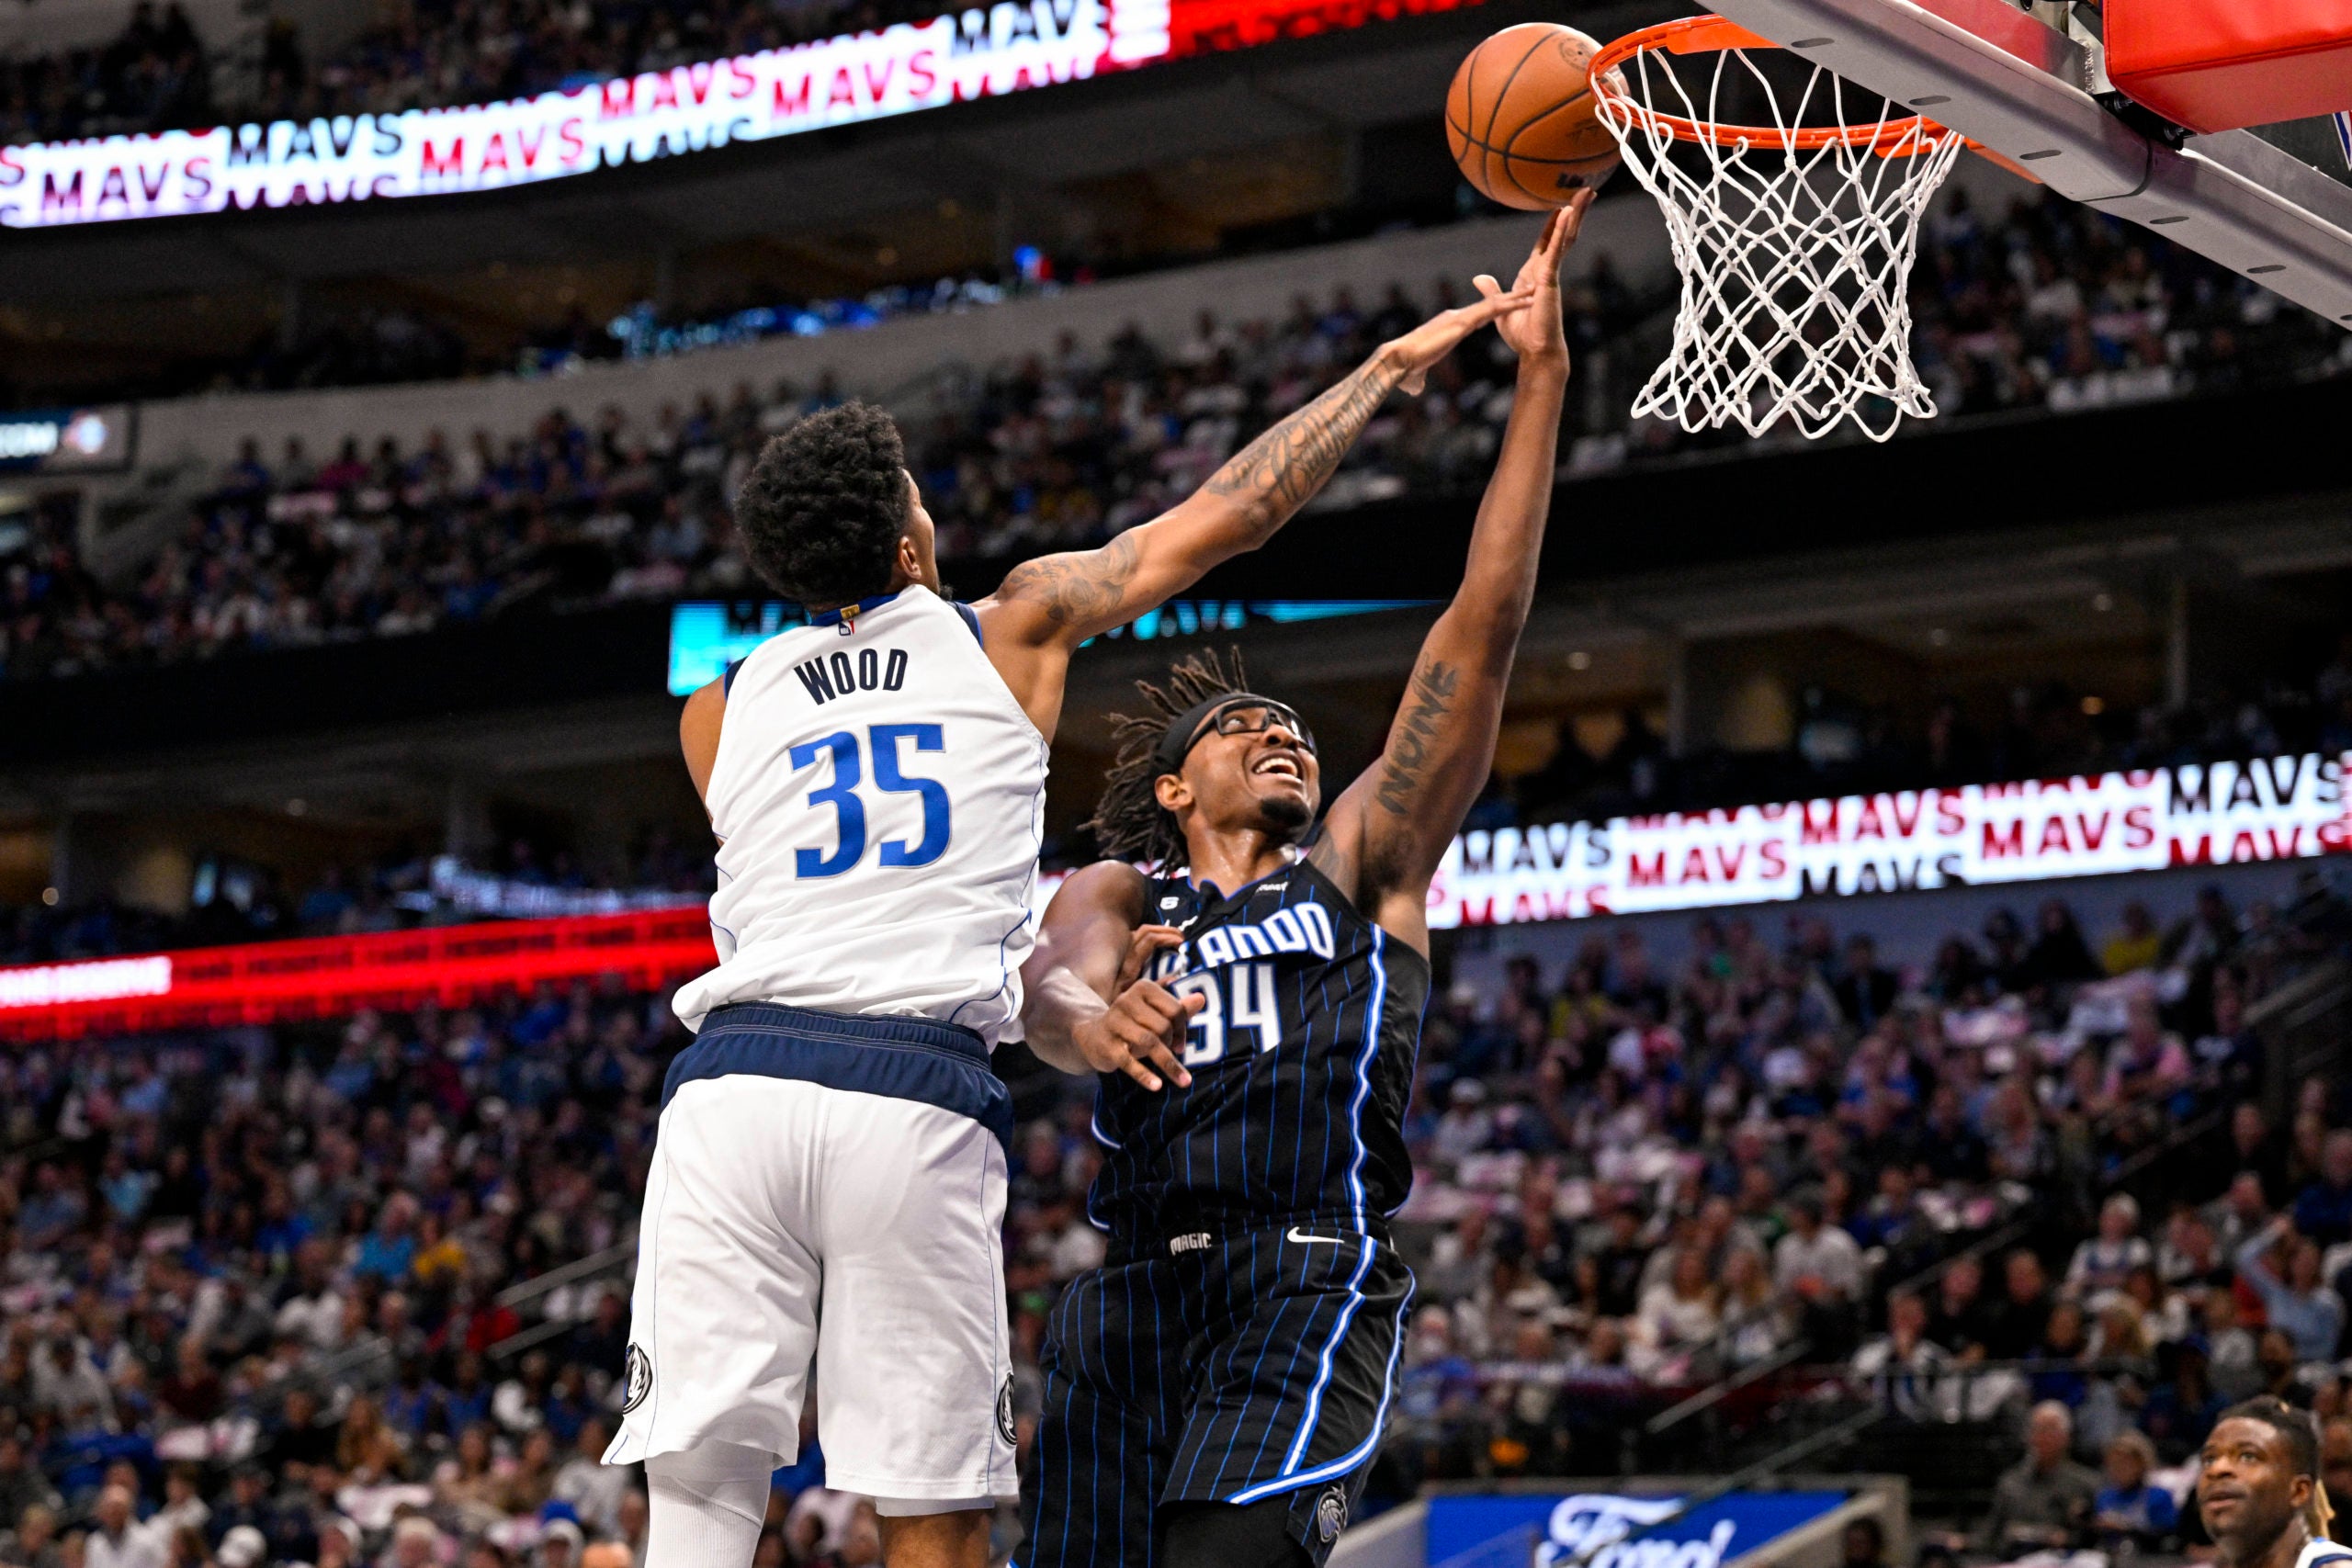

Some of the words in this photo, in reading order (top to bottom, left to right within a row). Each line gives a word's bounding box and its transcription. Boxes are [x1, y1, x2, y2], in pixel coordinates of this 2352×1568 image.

[602, 58, 754, 119] MAVS
[775, 44, 934, 118] MAVS
[229, 112, 401, 165] MAVS
[420, 118, 583, 177] MAVS
[42, 157, 211, 211] MAVS
[794, 649, 909, 705] WOOD
[787, 723, 952, 880] 35
[2169, 749, 2343, 816] MAVS
[1802, 794, 1966, 845] MAVS
[1984, 806, 2155, 859] MAVS
[1459, 822, 1611, 875] MAVS
[1627, 840, 1787, 887] MAVS
[1173, 962, 1283, 1067] 34
[1170, 1232, 1212, 1257] MAGIC
